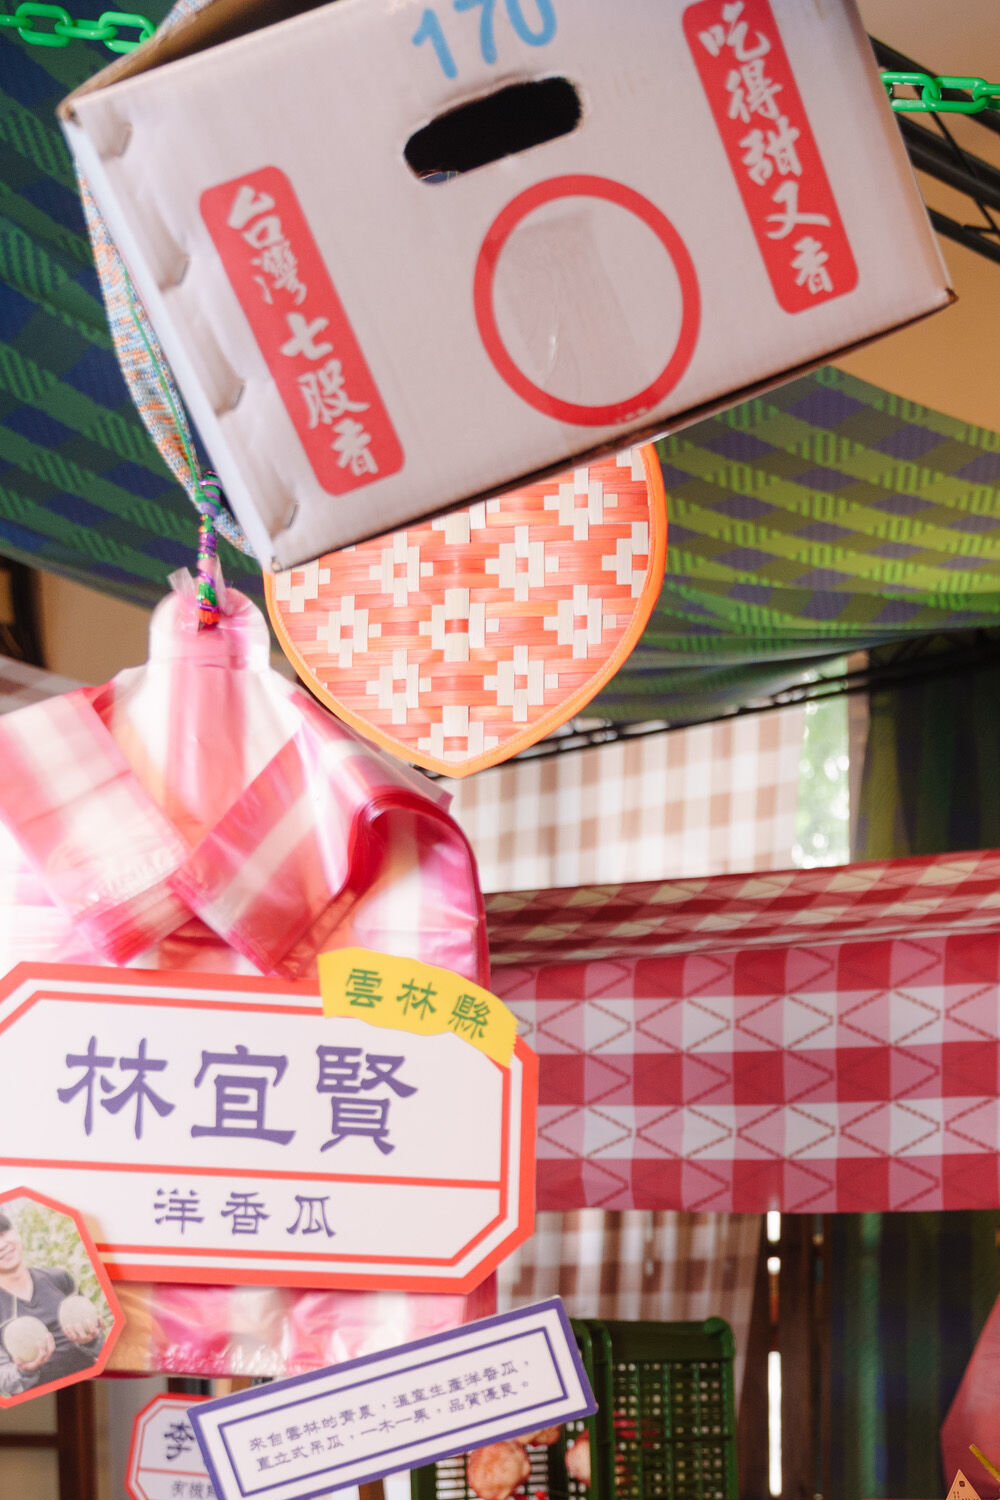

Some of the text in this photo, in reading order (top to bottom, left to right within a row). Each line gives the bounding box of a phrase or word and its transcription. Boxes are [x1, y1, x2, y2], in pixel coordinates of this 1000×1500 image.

[411, 0, 558, 80] 170
[697, 0, 834, 296] 吃得甜又香
[226, 184, 380, 478] 台灣七股香
[344, 967, 493, 1041] 雲林縣
[56, 1034, 419, 1156] 林宜賢
[152, 1187, 337, 1239] 洋香瓜
